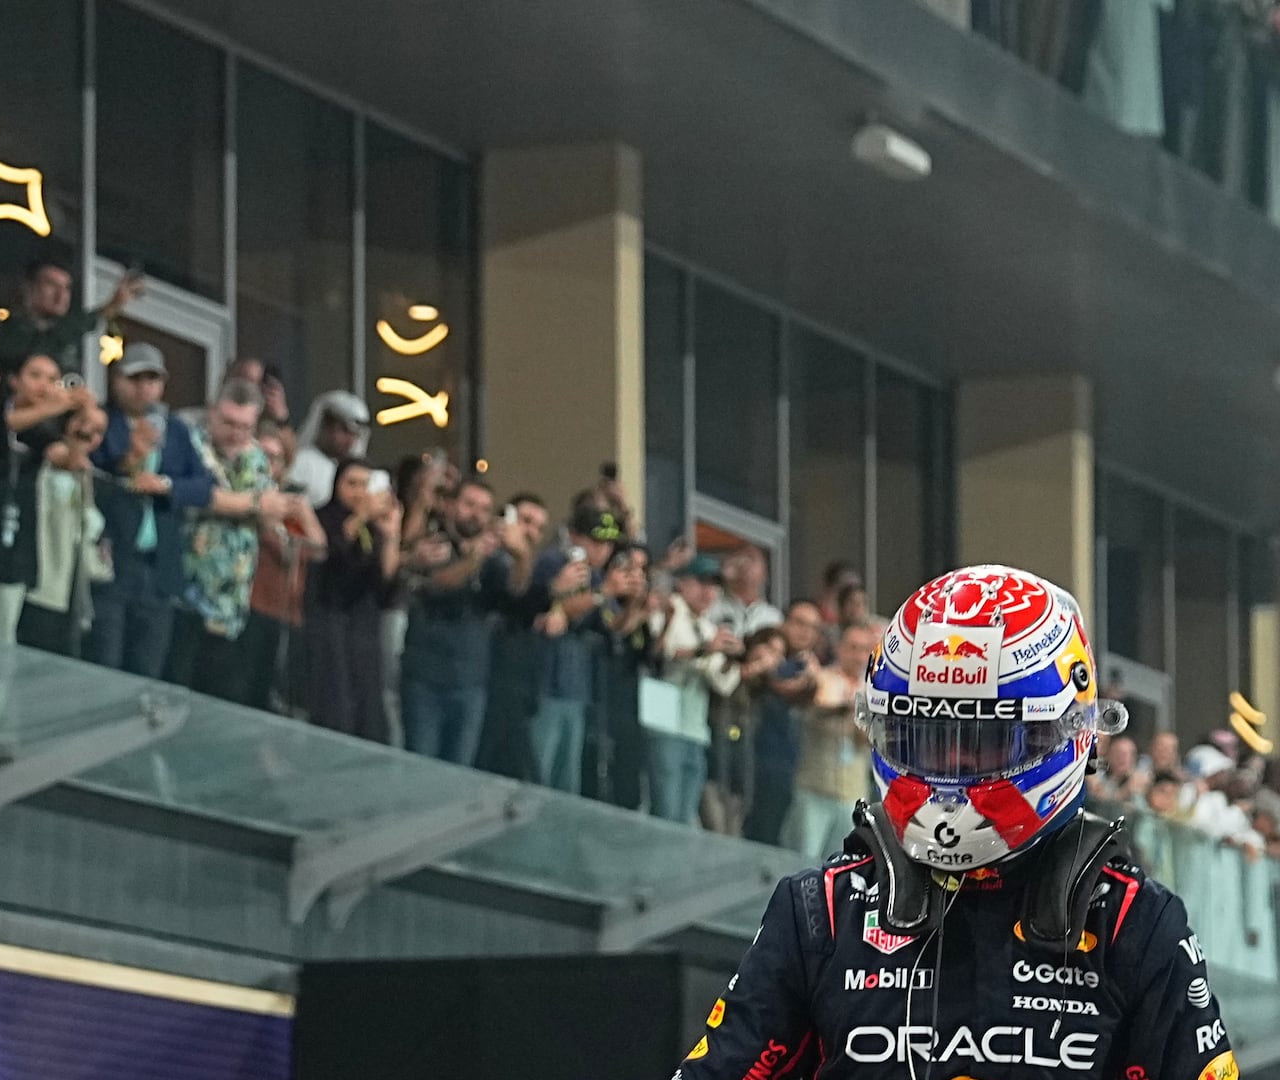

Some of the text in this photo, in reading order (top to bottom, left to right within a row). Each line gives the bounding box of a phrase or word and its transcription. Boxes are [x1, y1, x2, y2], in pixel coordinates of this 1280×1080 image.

[1011, 623, 1063, 665] Heineken
[917, 665, 987, 685] Red Bull
[891, 695, 1016, 720] ORACLE
[844, 968, 907, 991] Mobil
[1012, 996, 1100, 1016] HONDA
[845, 1025, 1100, 1070] ORACLE
